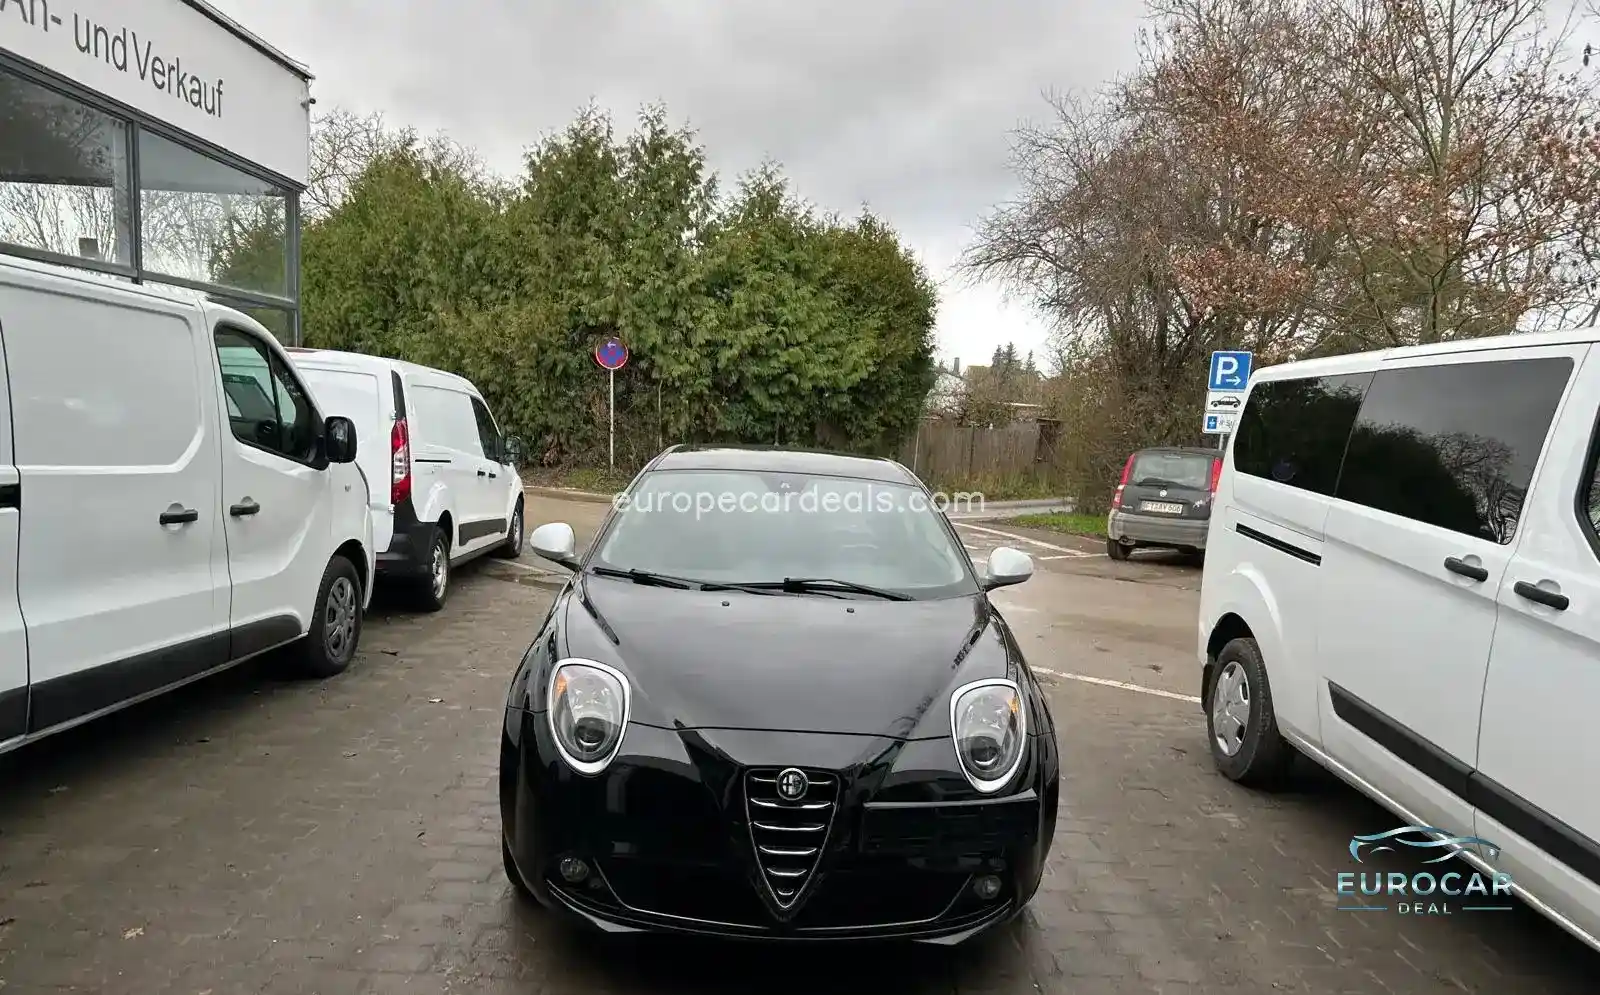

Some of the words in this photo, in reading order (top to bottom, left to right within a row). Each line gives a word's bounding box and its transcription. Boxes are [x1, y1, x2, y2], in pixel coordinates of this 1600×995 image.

[74, 12, 128, 72] und
[132, 31, 224, 118] Verkauf
[1215, 356, 1239, 385] P
